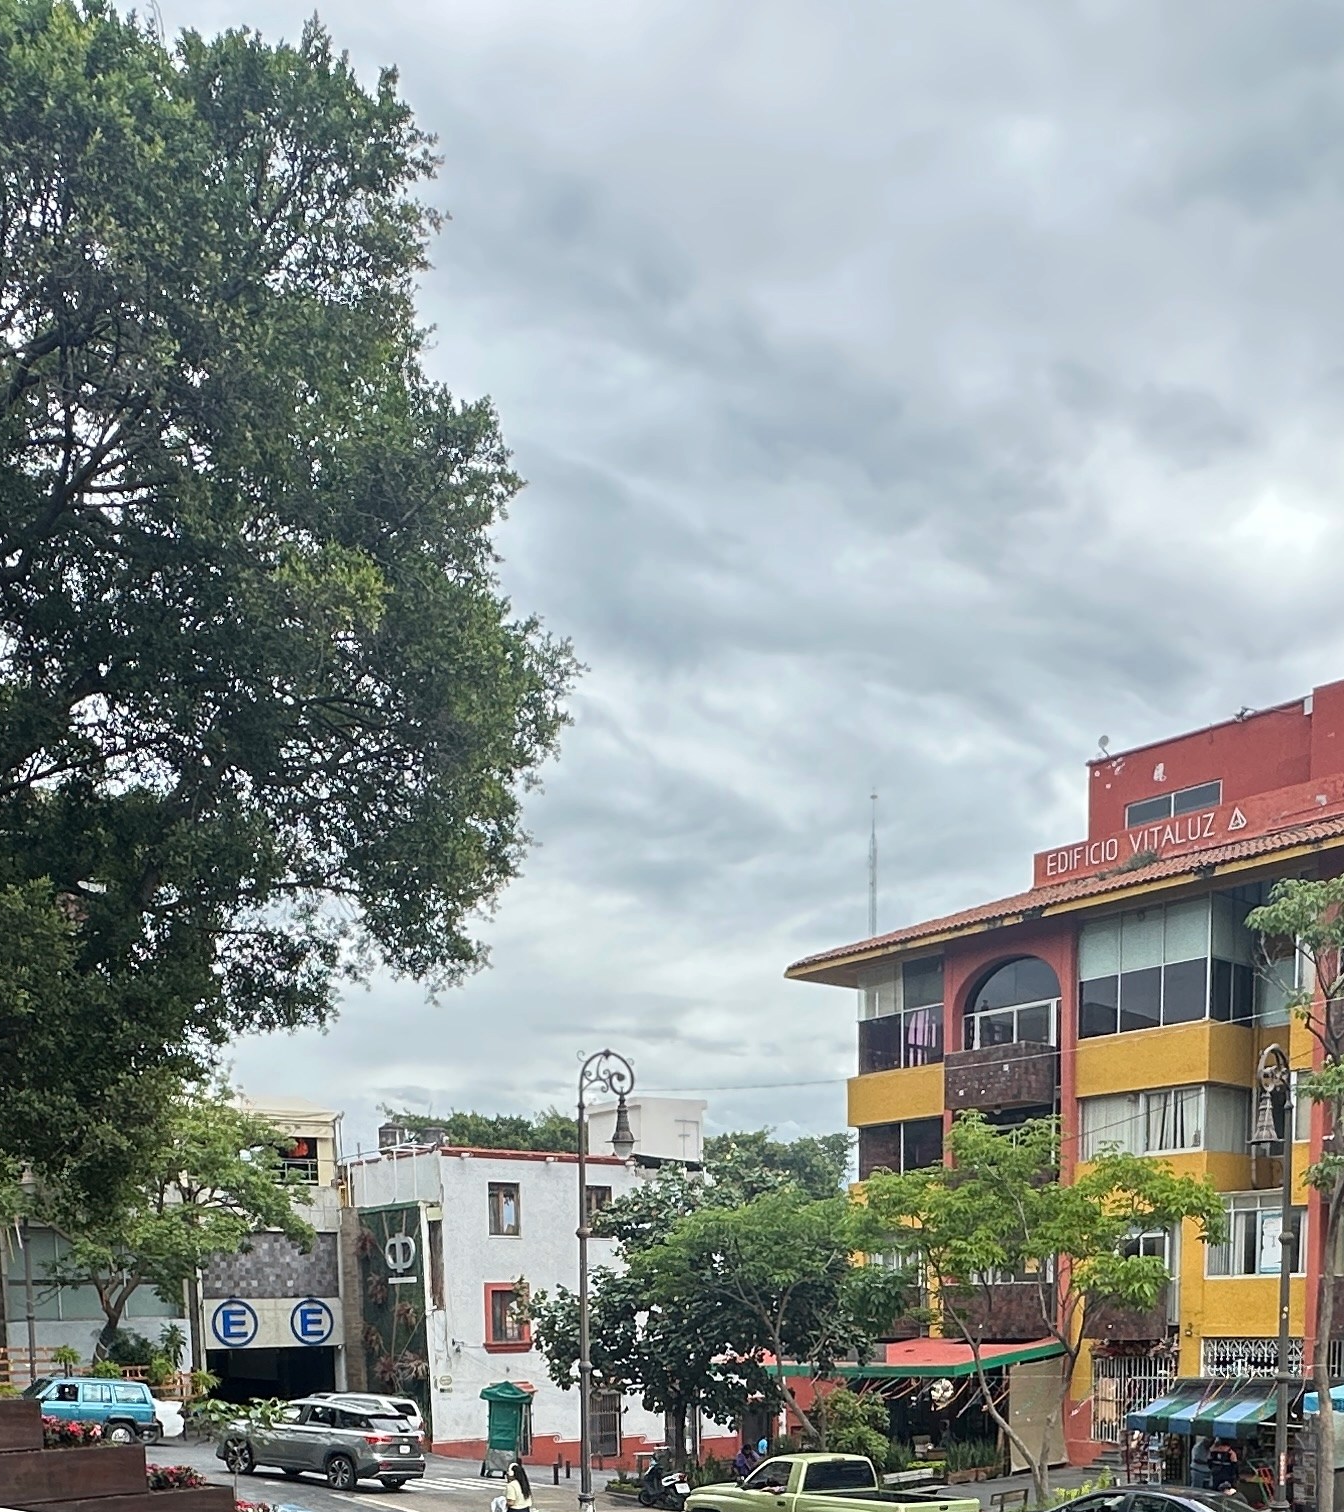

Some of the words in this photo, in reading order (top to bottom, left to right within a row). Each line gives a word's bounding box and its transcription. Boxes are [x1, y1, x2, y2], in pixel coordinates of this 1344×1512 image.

[1046, 838, 1118, 876] EDIFICIO
[1129, 812, 1215, 853] VITALUZ
[222, 1309, 248, 1338] E
[300, 1308, 324, 1336] E
